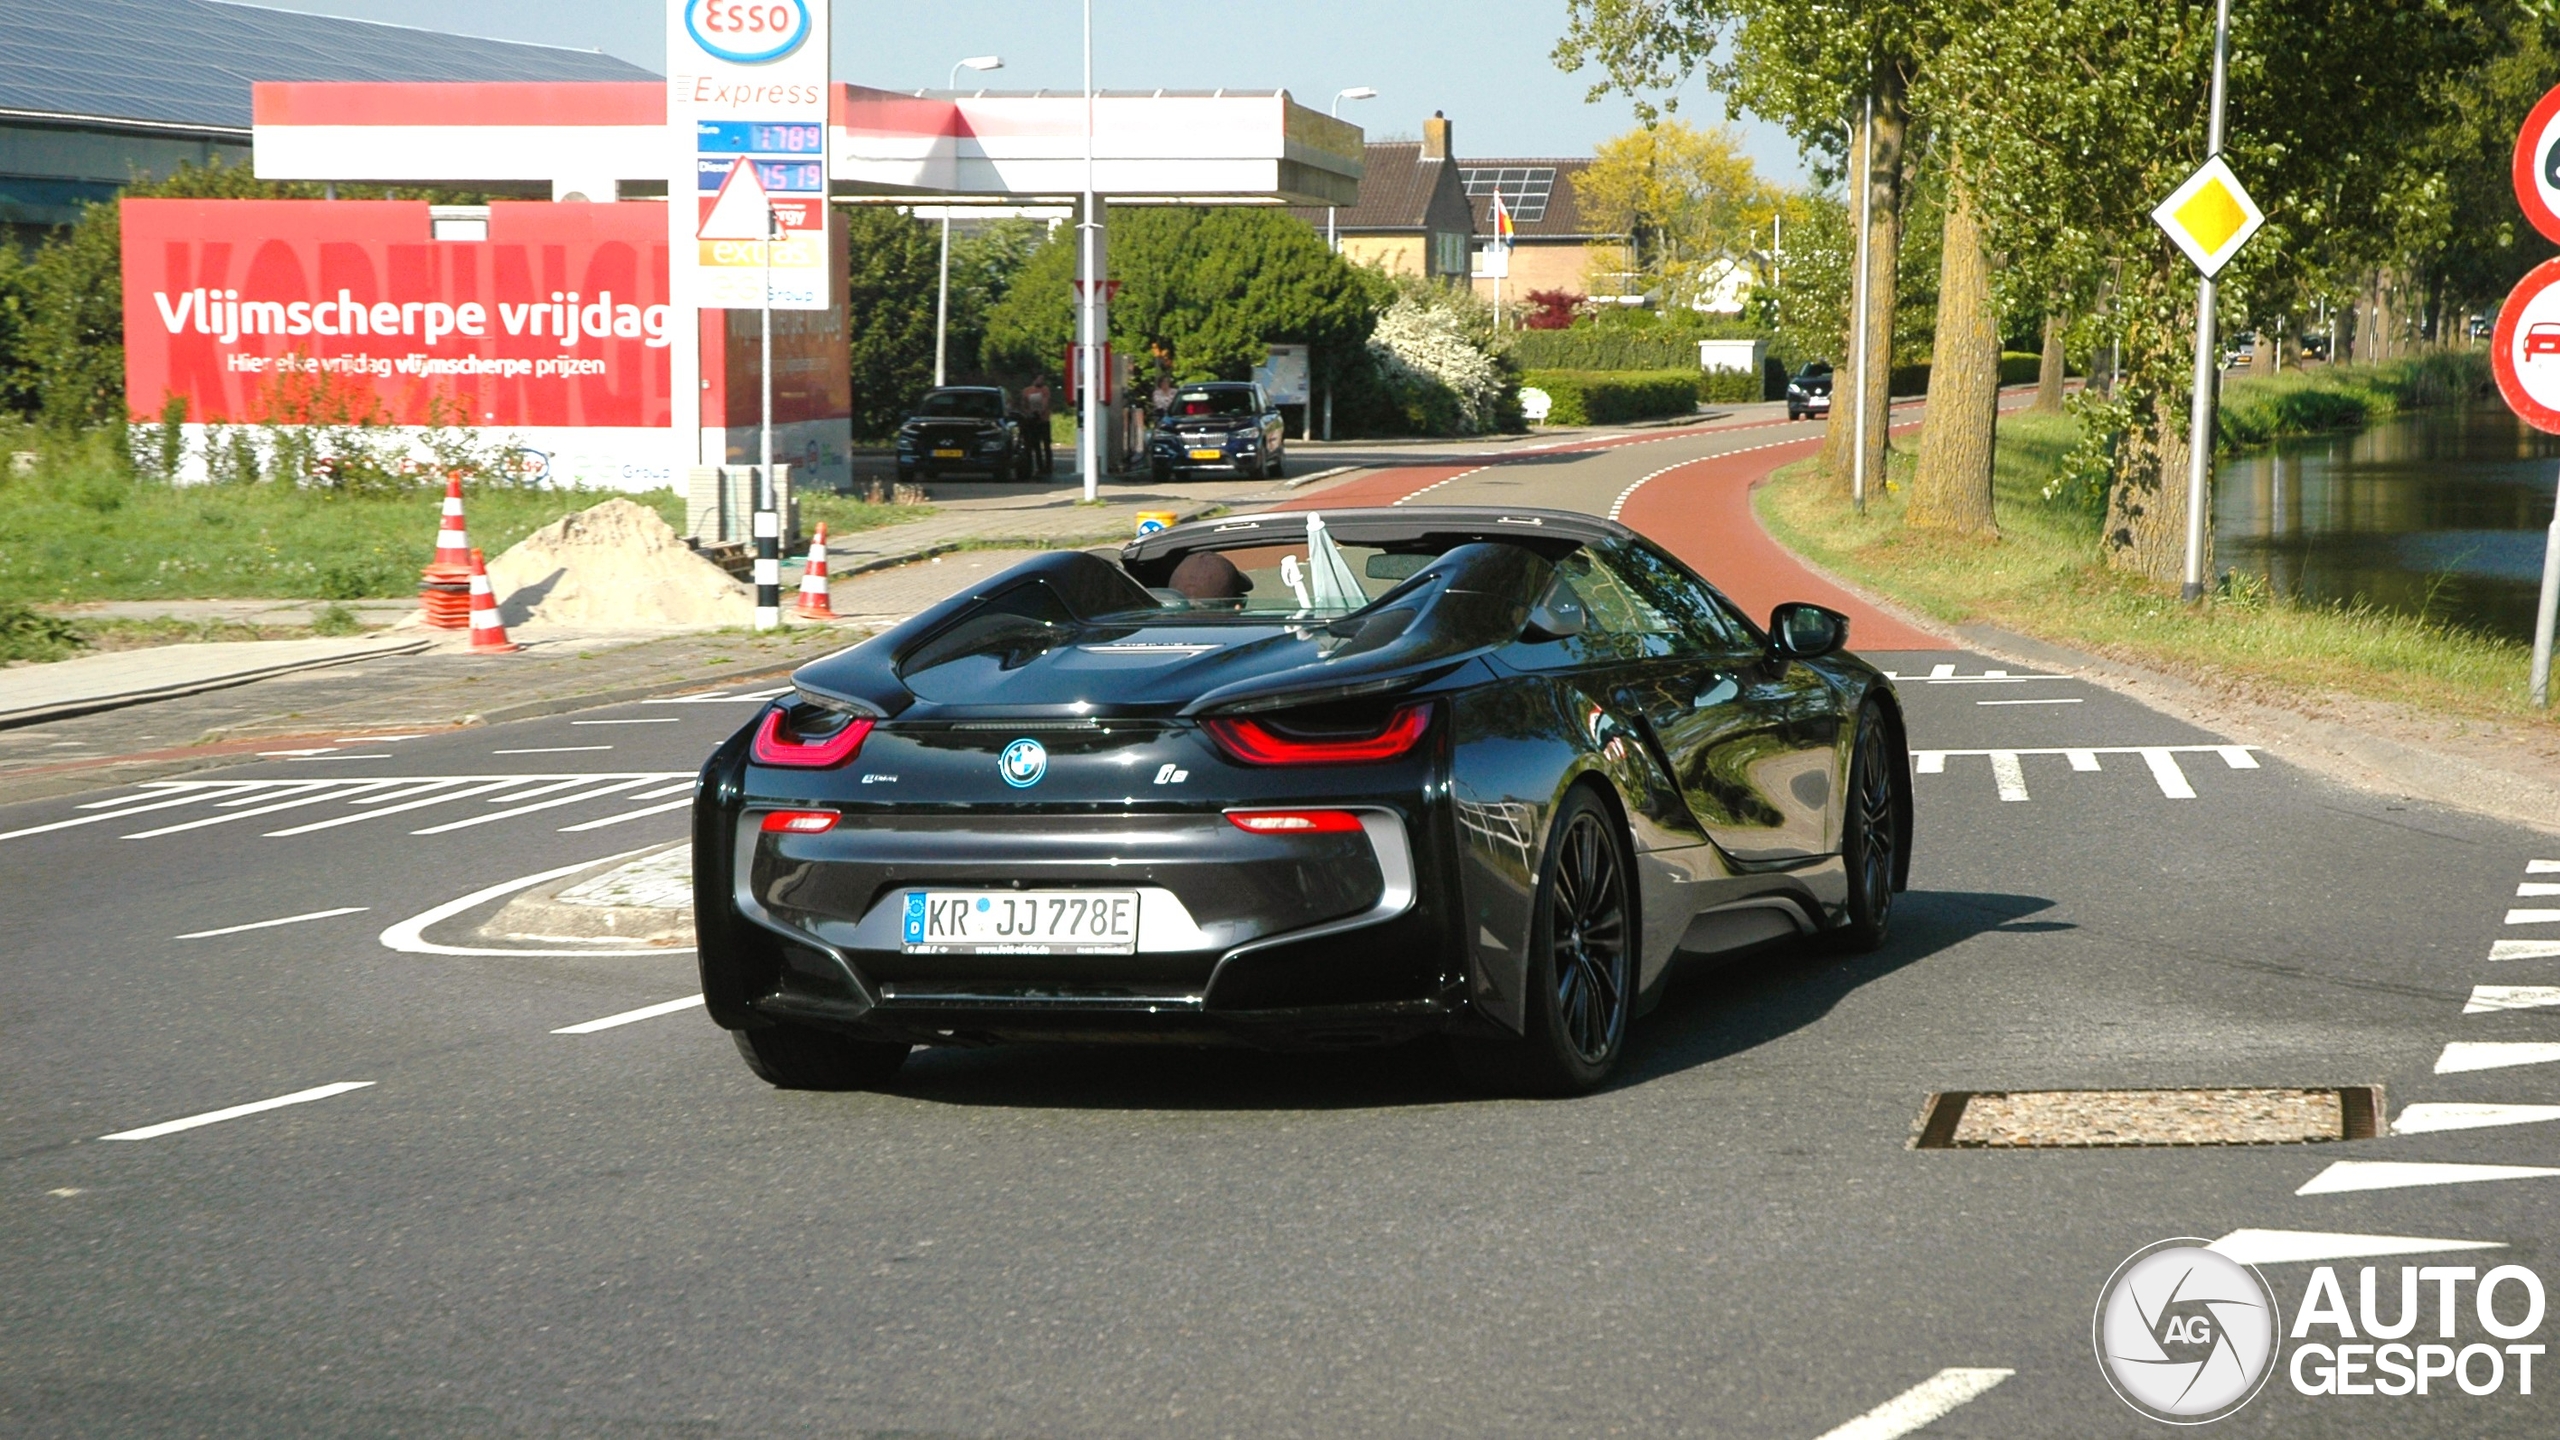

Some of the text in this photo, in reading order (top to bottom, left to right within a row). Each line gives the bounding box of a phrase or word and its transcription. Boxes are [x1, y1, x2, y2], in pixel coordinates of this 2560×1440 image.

[694, 76, 819, 108] Express
[153, 287, 487, 345] Vlijmscherpe
[498, 290, 671, 348] vrijdag
[227, 353, 271, 372] Hier
[321, 353, 391, 378] vrijdag
[394, 353, 531, 378] vlijmscherpe
[536, 355, 605, 378] prijzen
[910, 898, 1131, 936] D KR JJ 778E
